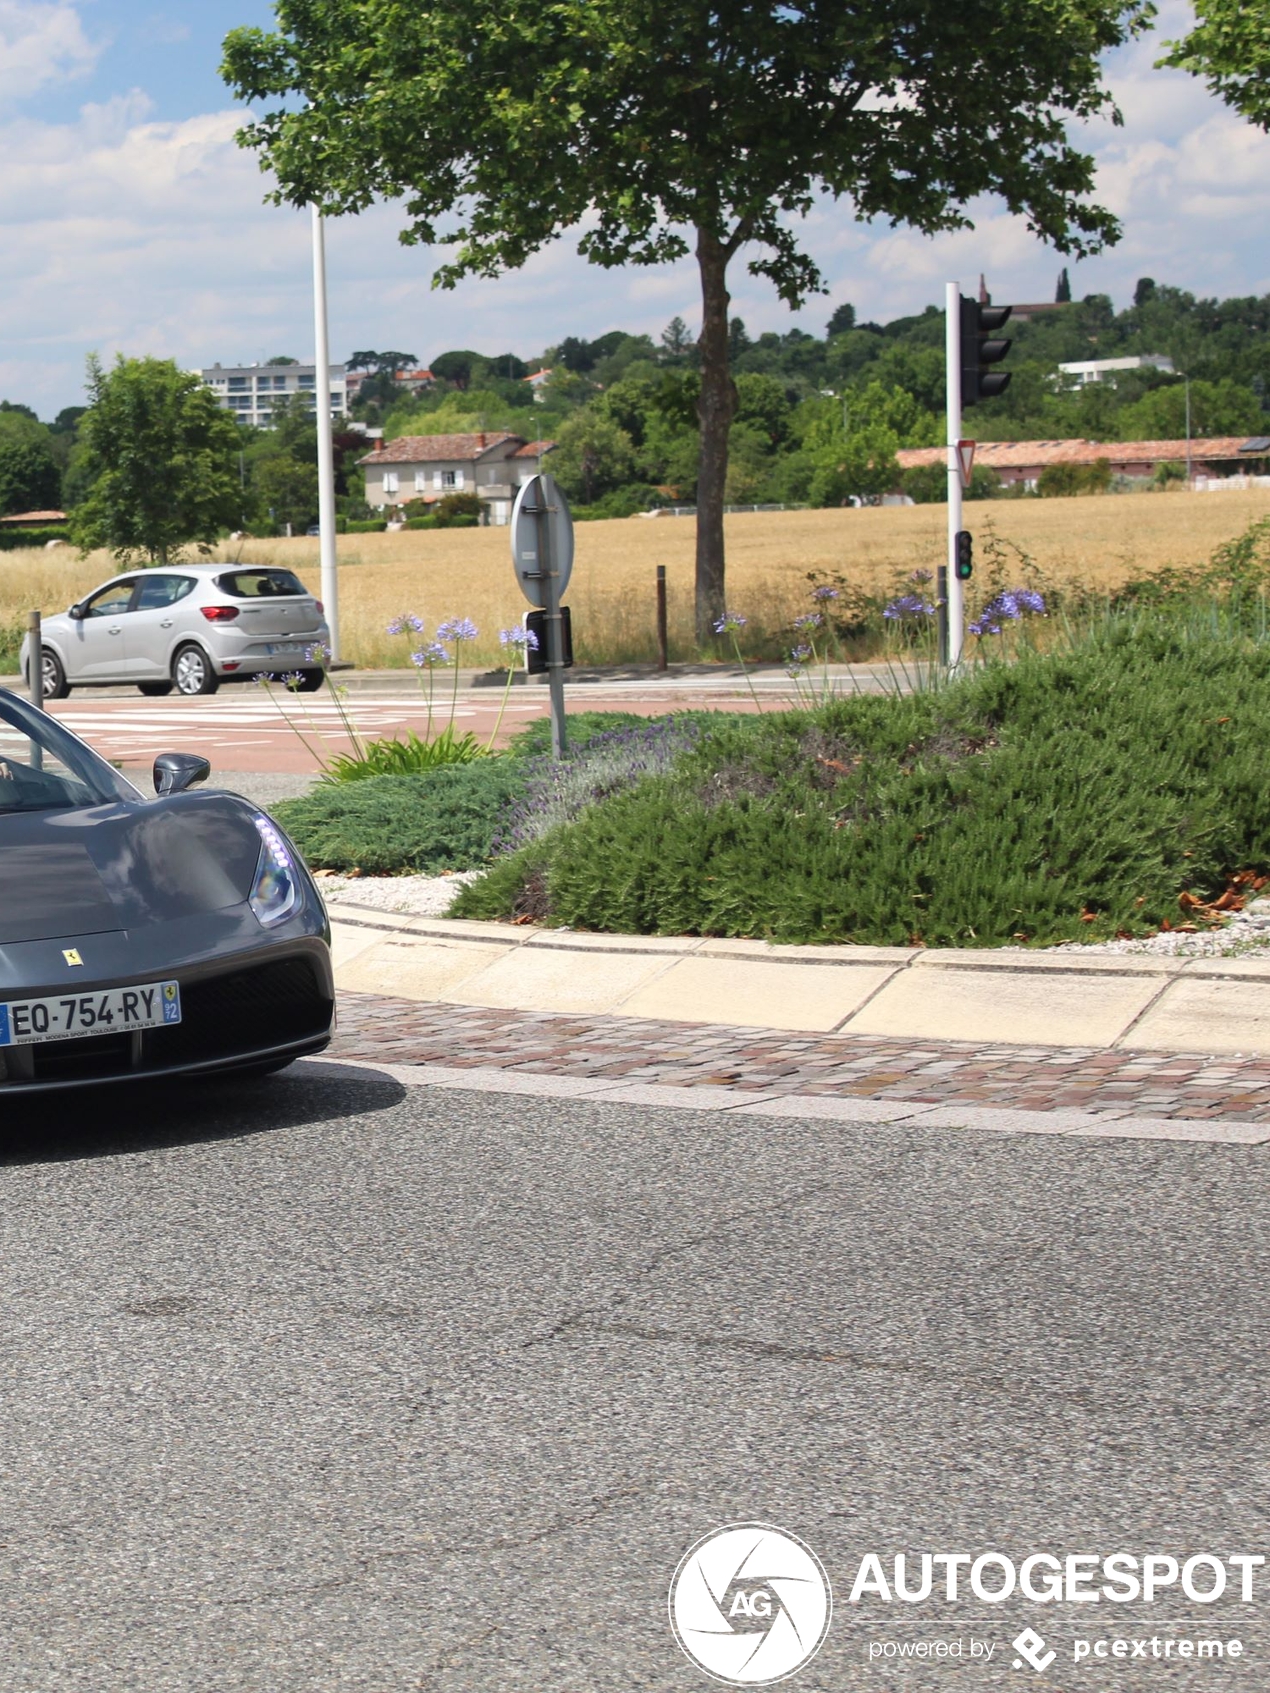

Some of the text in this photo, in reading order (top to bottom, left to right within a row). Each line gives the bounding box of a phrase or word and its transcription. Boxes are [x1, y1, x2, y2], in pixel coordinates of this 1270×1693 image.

[11, 988, 155, 1036] EQ-754-RY
[45, 1033, 70, 1041] MODENA
[71, 1030, 88, 1038] SPORT
